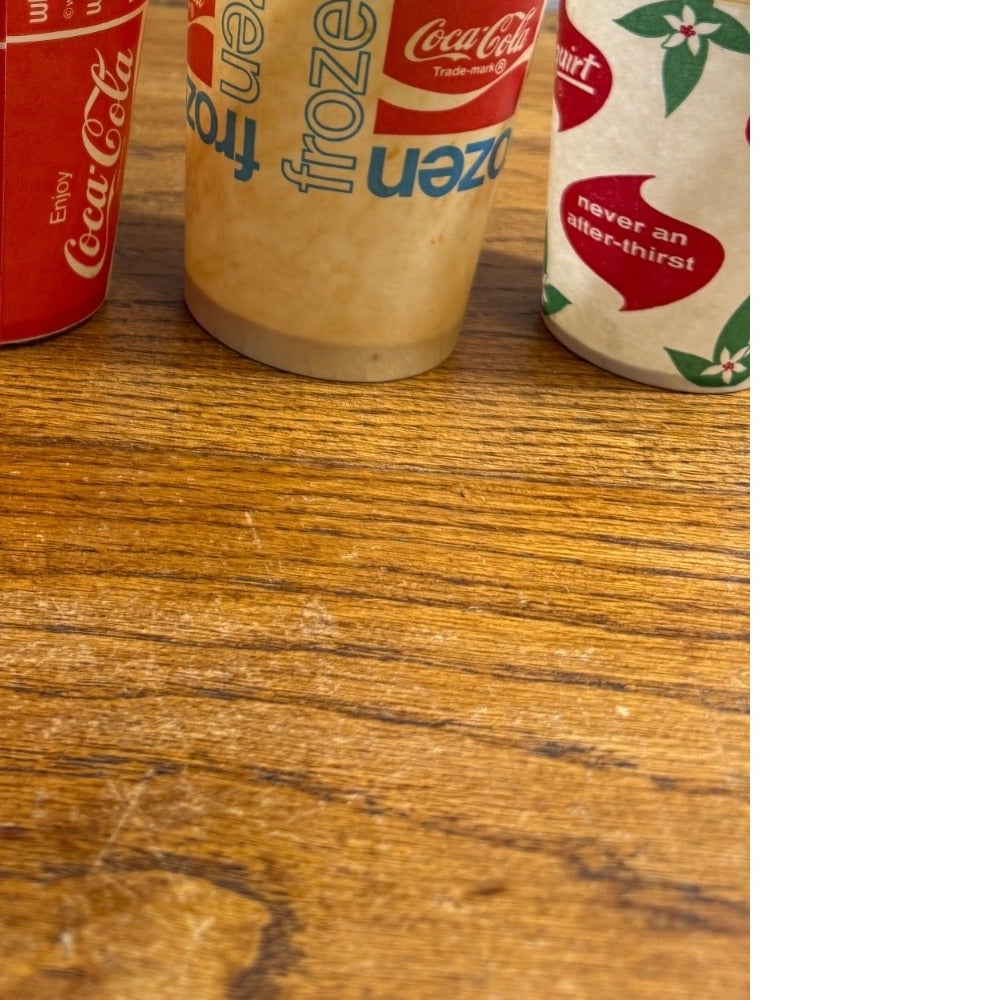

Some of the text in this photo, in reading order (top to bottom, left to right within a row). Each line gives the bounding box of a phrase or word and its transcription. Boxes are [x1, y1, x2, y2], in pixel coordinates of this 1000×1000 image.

[404, 7, 537, 62] Coca-Cola
[64, 48, 133, 279] Coca-Cola
[50, 171, 72, 225] Enjoy
[577, 195, 689, 247] never an
[567, 212, 696, 272] after-thirst
